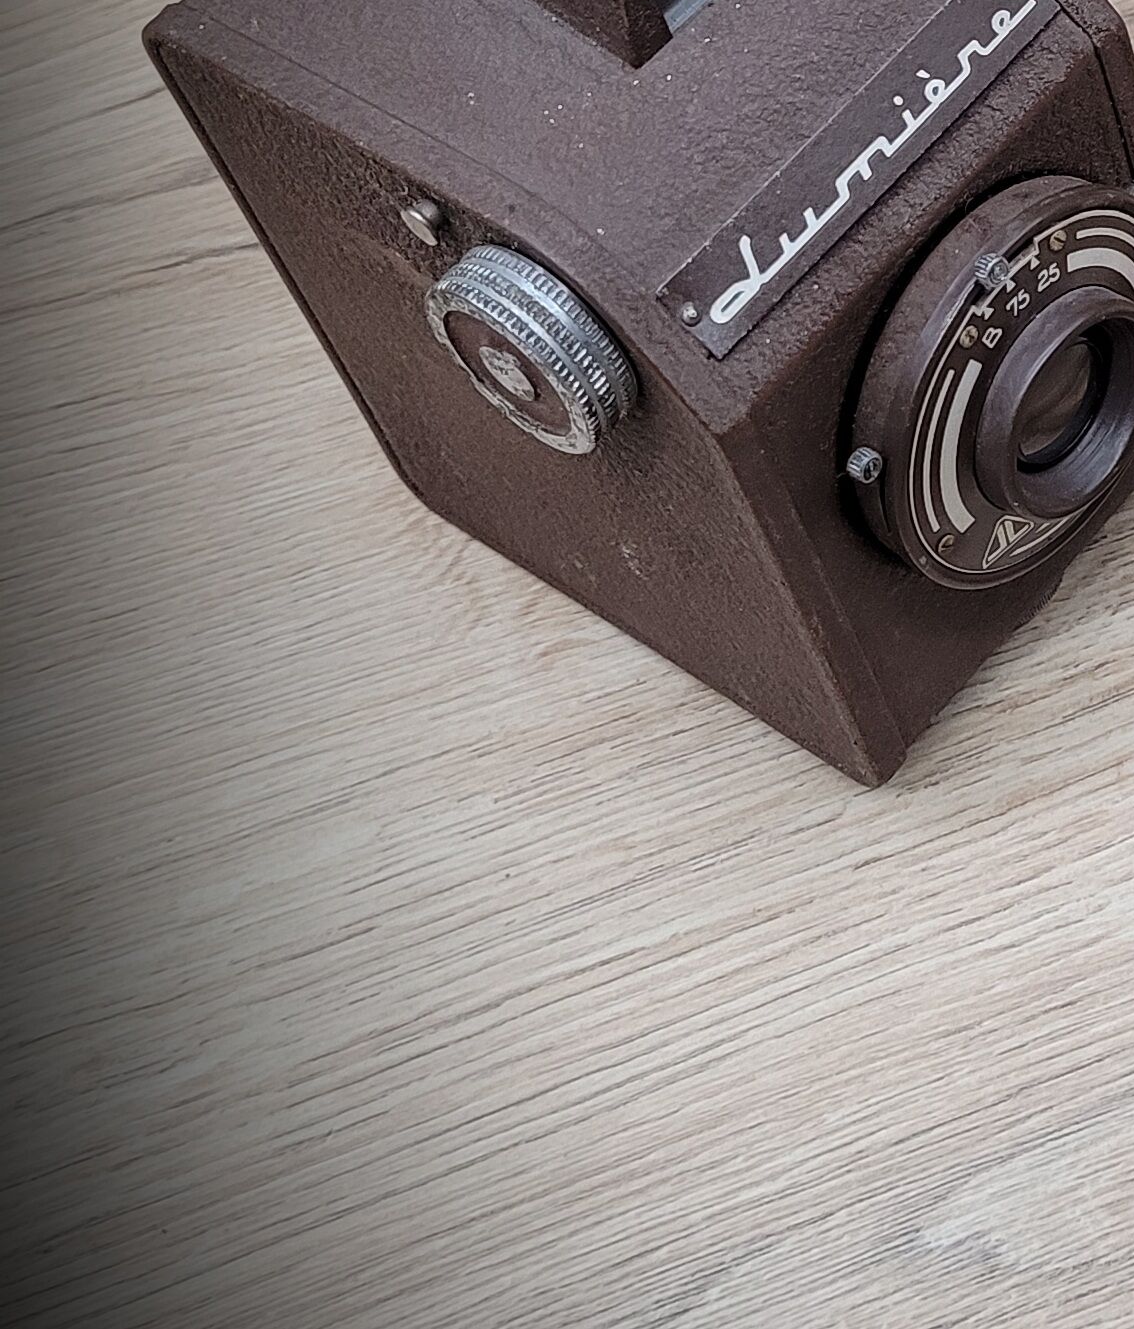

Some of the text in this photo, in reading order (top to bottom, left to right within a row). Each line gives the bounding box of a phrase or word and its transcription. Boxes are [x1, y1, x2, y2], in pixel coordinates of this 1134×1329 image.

[981, 262, 1061, 349] B 75 25
